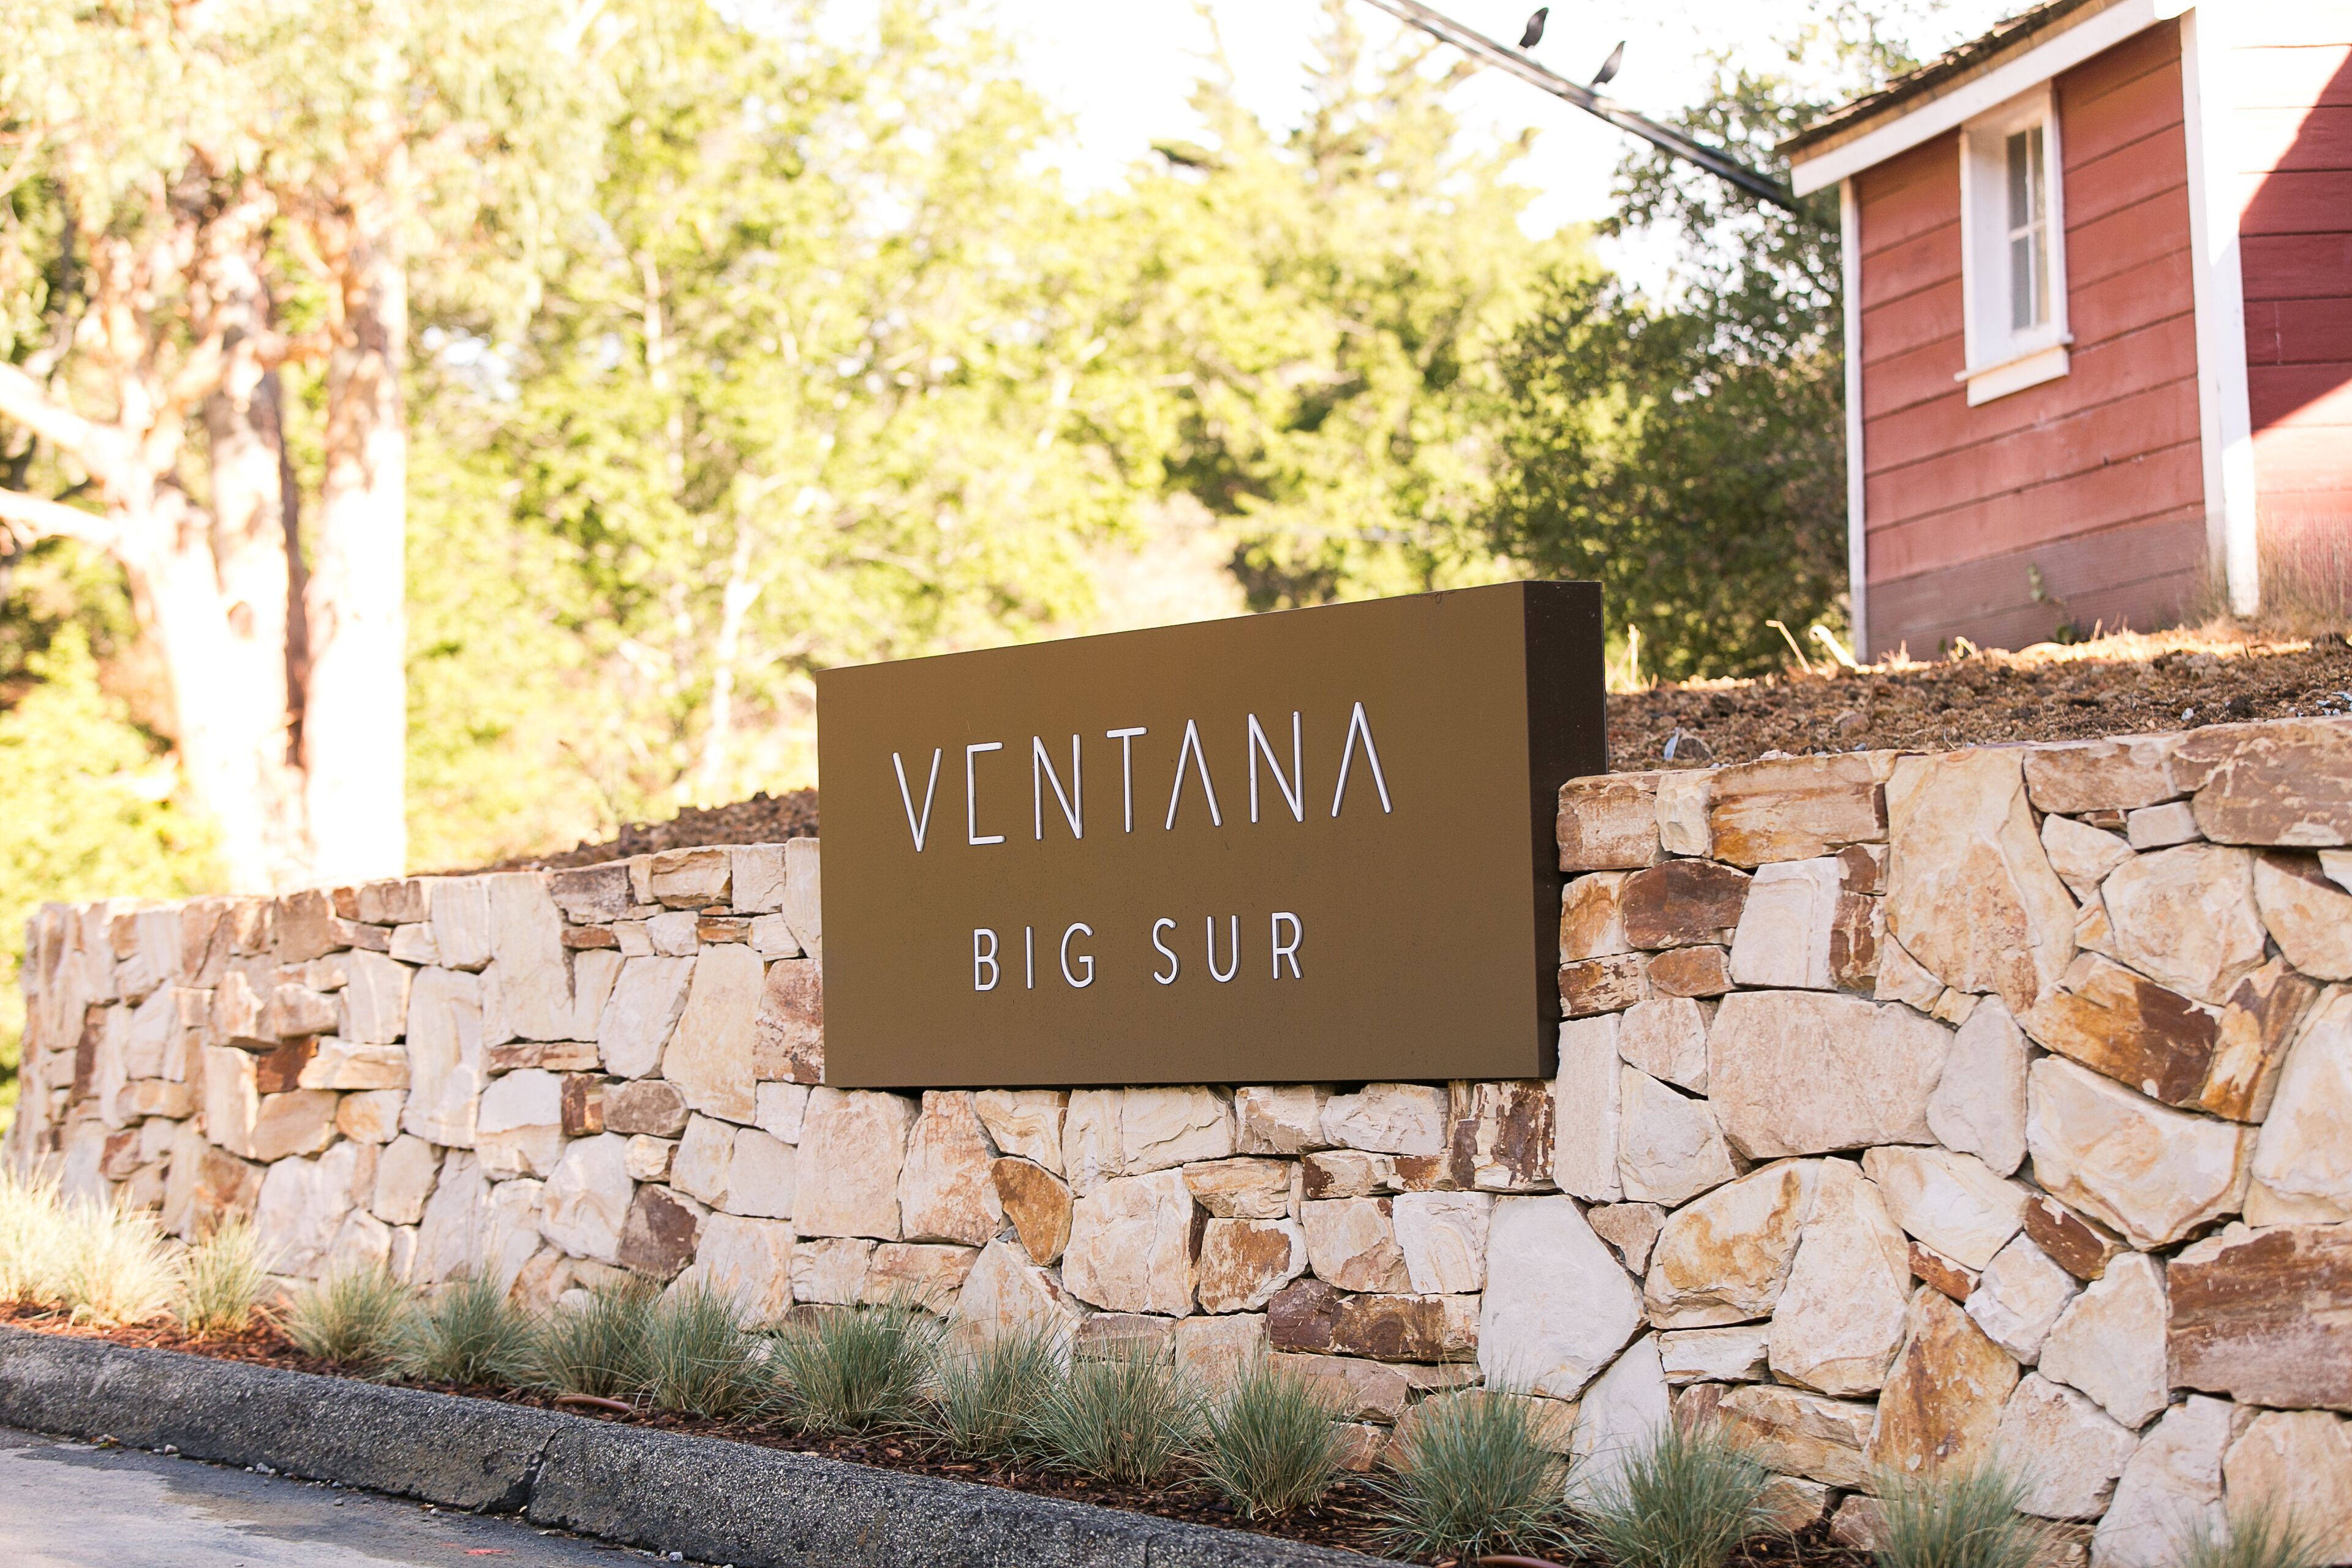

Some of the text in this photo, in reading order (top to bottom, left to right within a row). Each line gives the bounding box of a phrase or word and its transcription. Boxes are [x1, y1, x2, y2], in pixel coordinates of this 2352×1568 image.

[892, 701, 1392, 853] VENTANA
[973, 911, 1304, 992] BIG SUR
